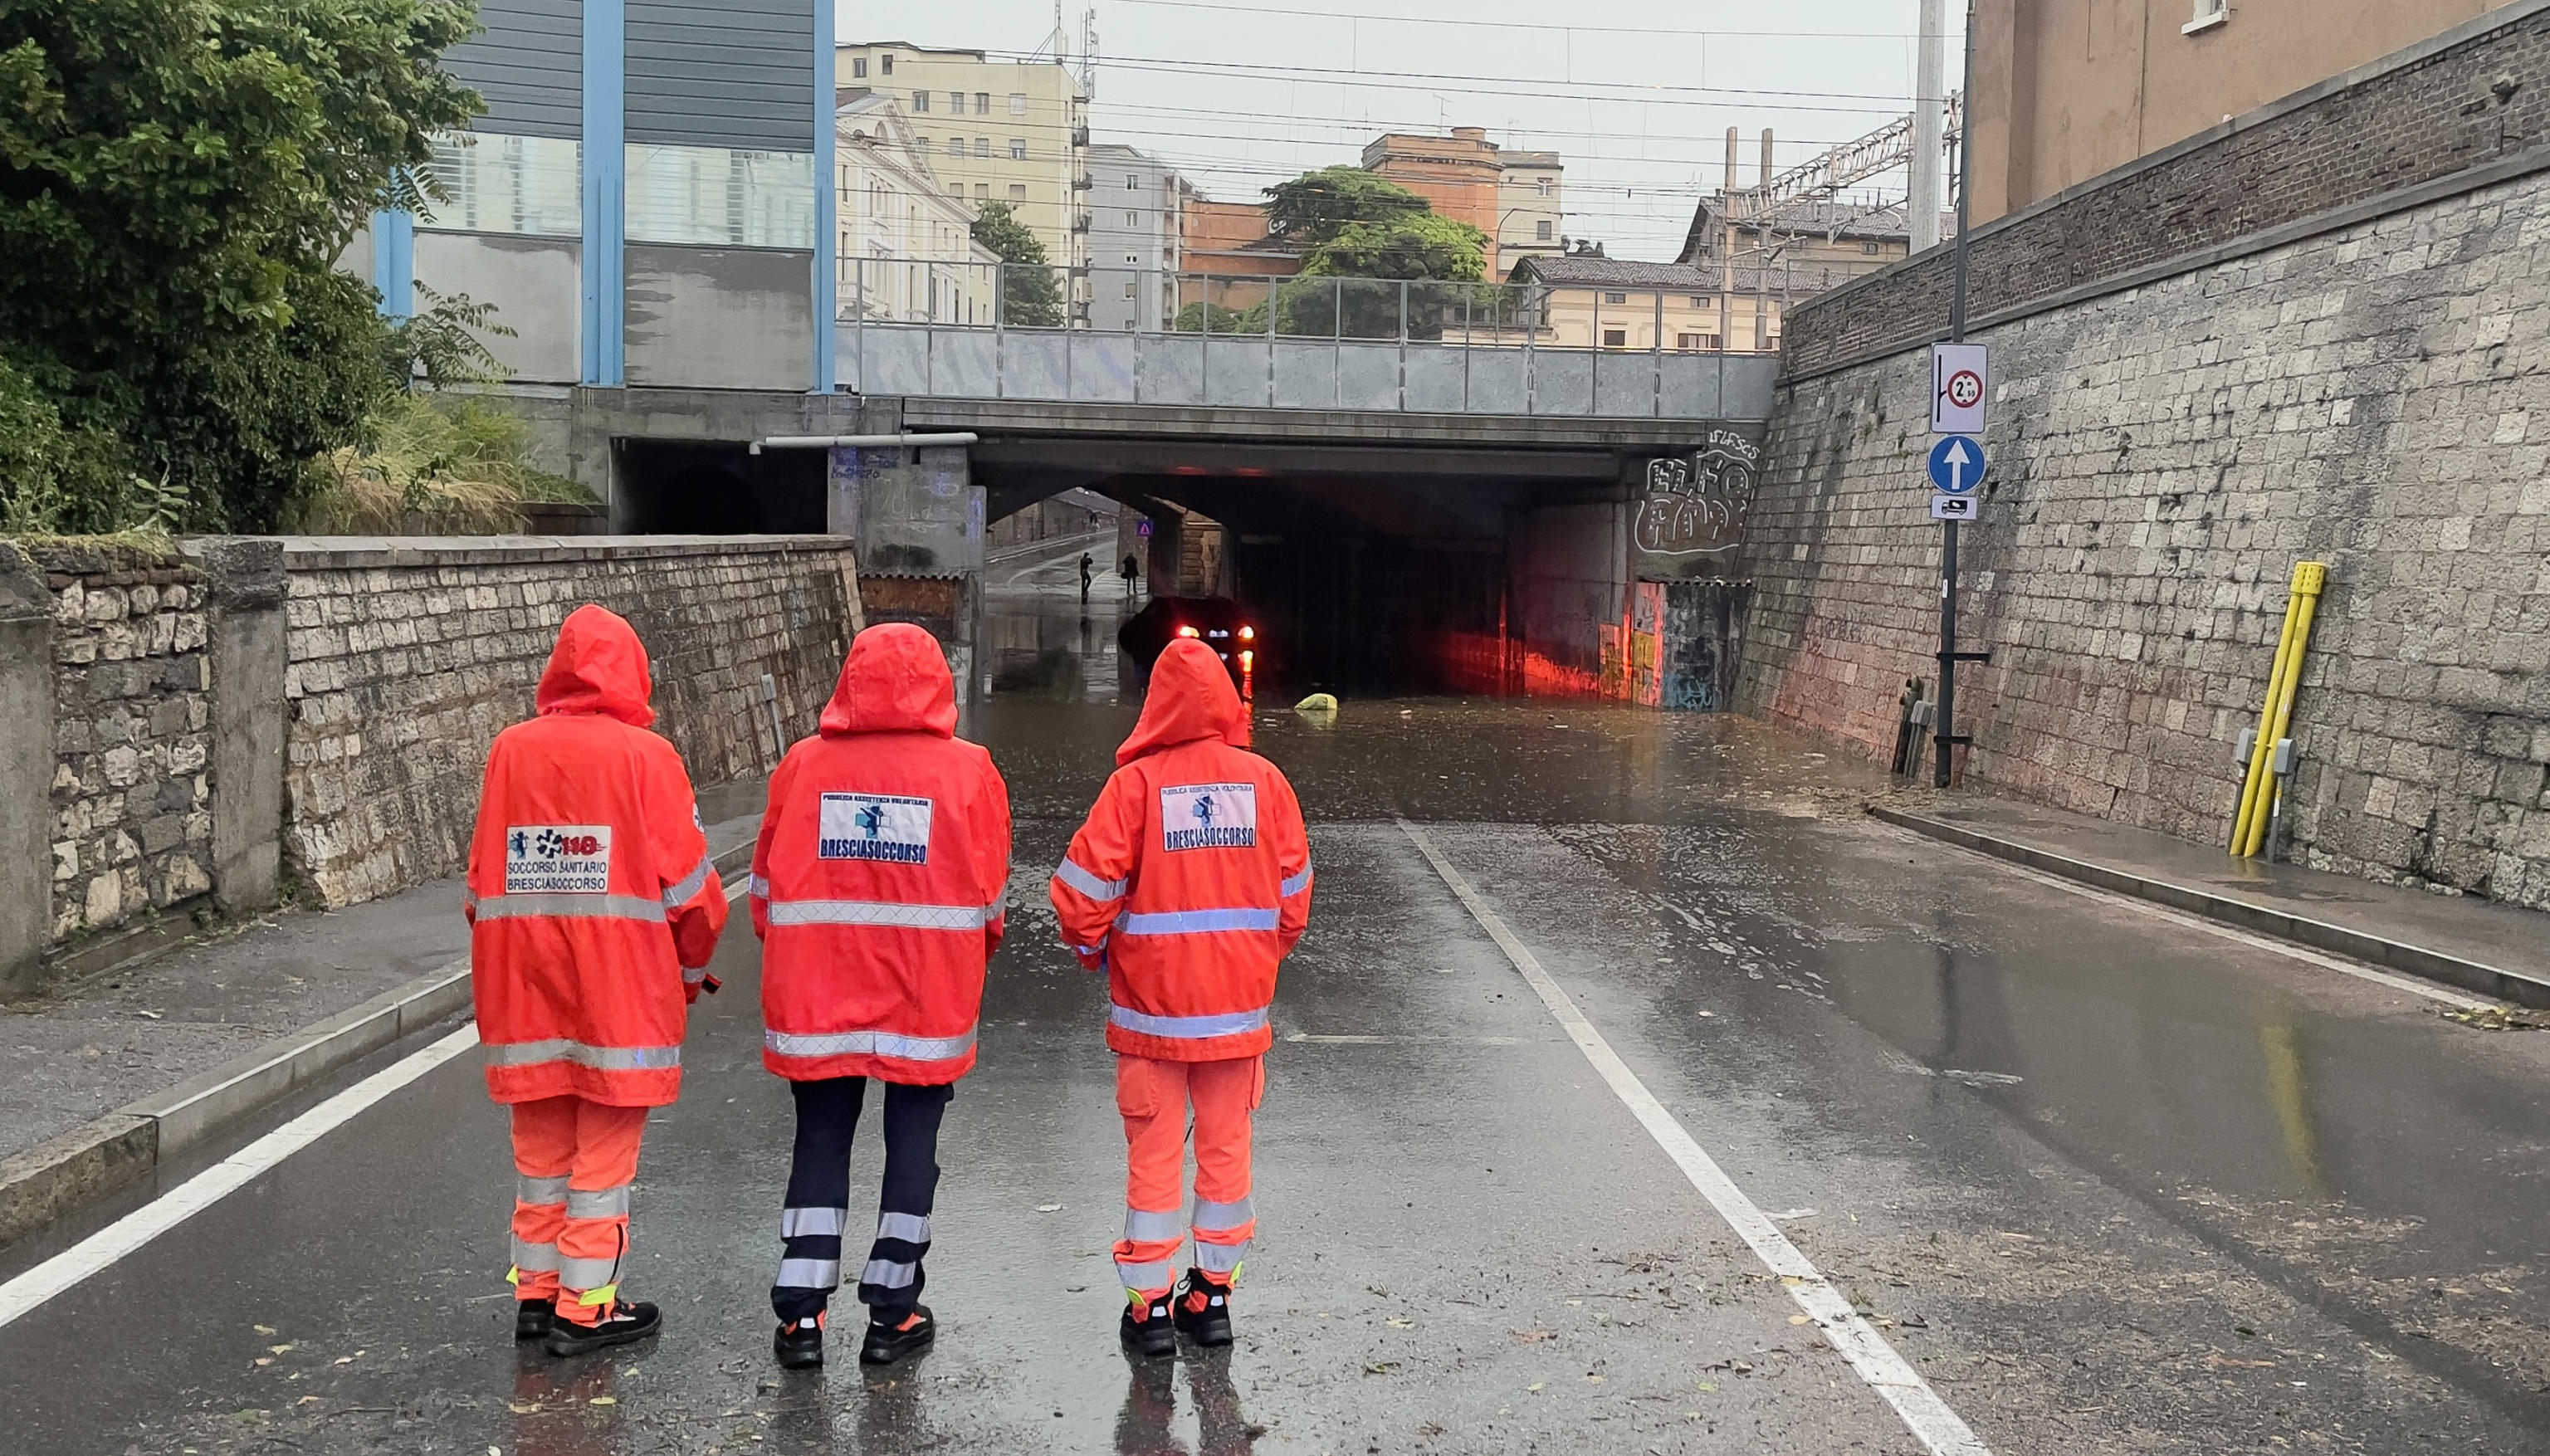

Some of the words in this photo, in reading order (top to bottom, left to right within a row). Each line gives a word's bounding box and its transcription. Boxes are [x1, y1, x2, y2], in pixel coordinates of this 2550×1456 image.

[1956, 381, 1964, 397] 2
[561, 836, 598, 856] 118
[1166, 827, 1253, 849] BRESCIASOCCORSO
[820, 838, 926, 863] BRESCIASOCCORSO
[508, 862, 557, 874] SOCCORSO
[559, 861, 607, 873] SANITARIO
[507, 877, 606, 891] BRESCIASOCCORSO
